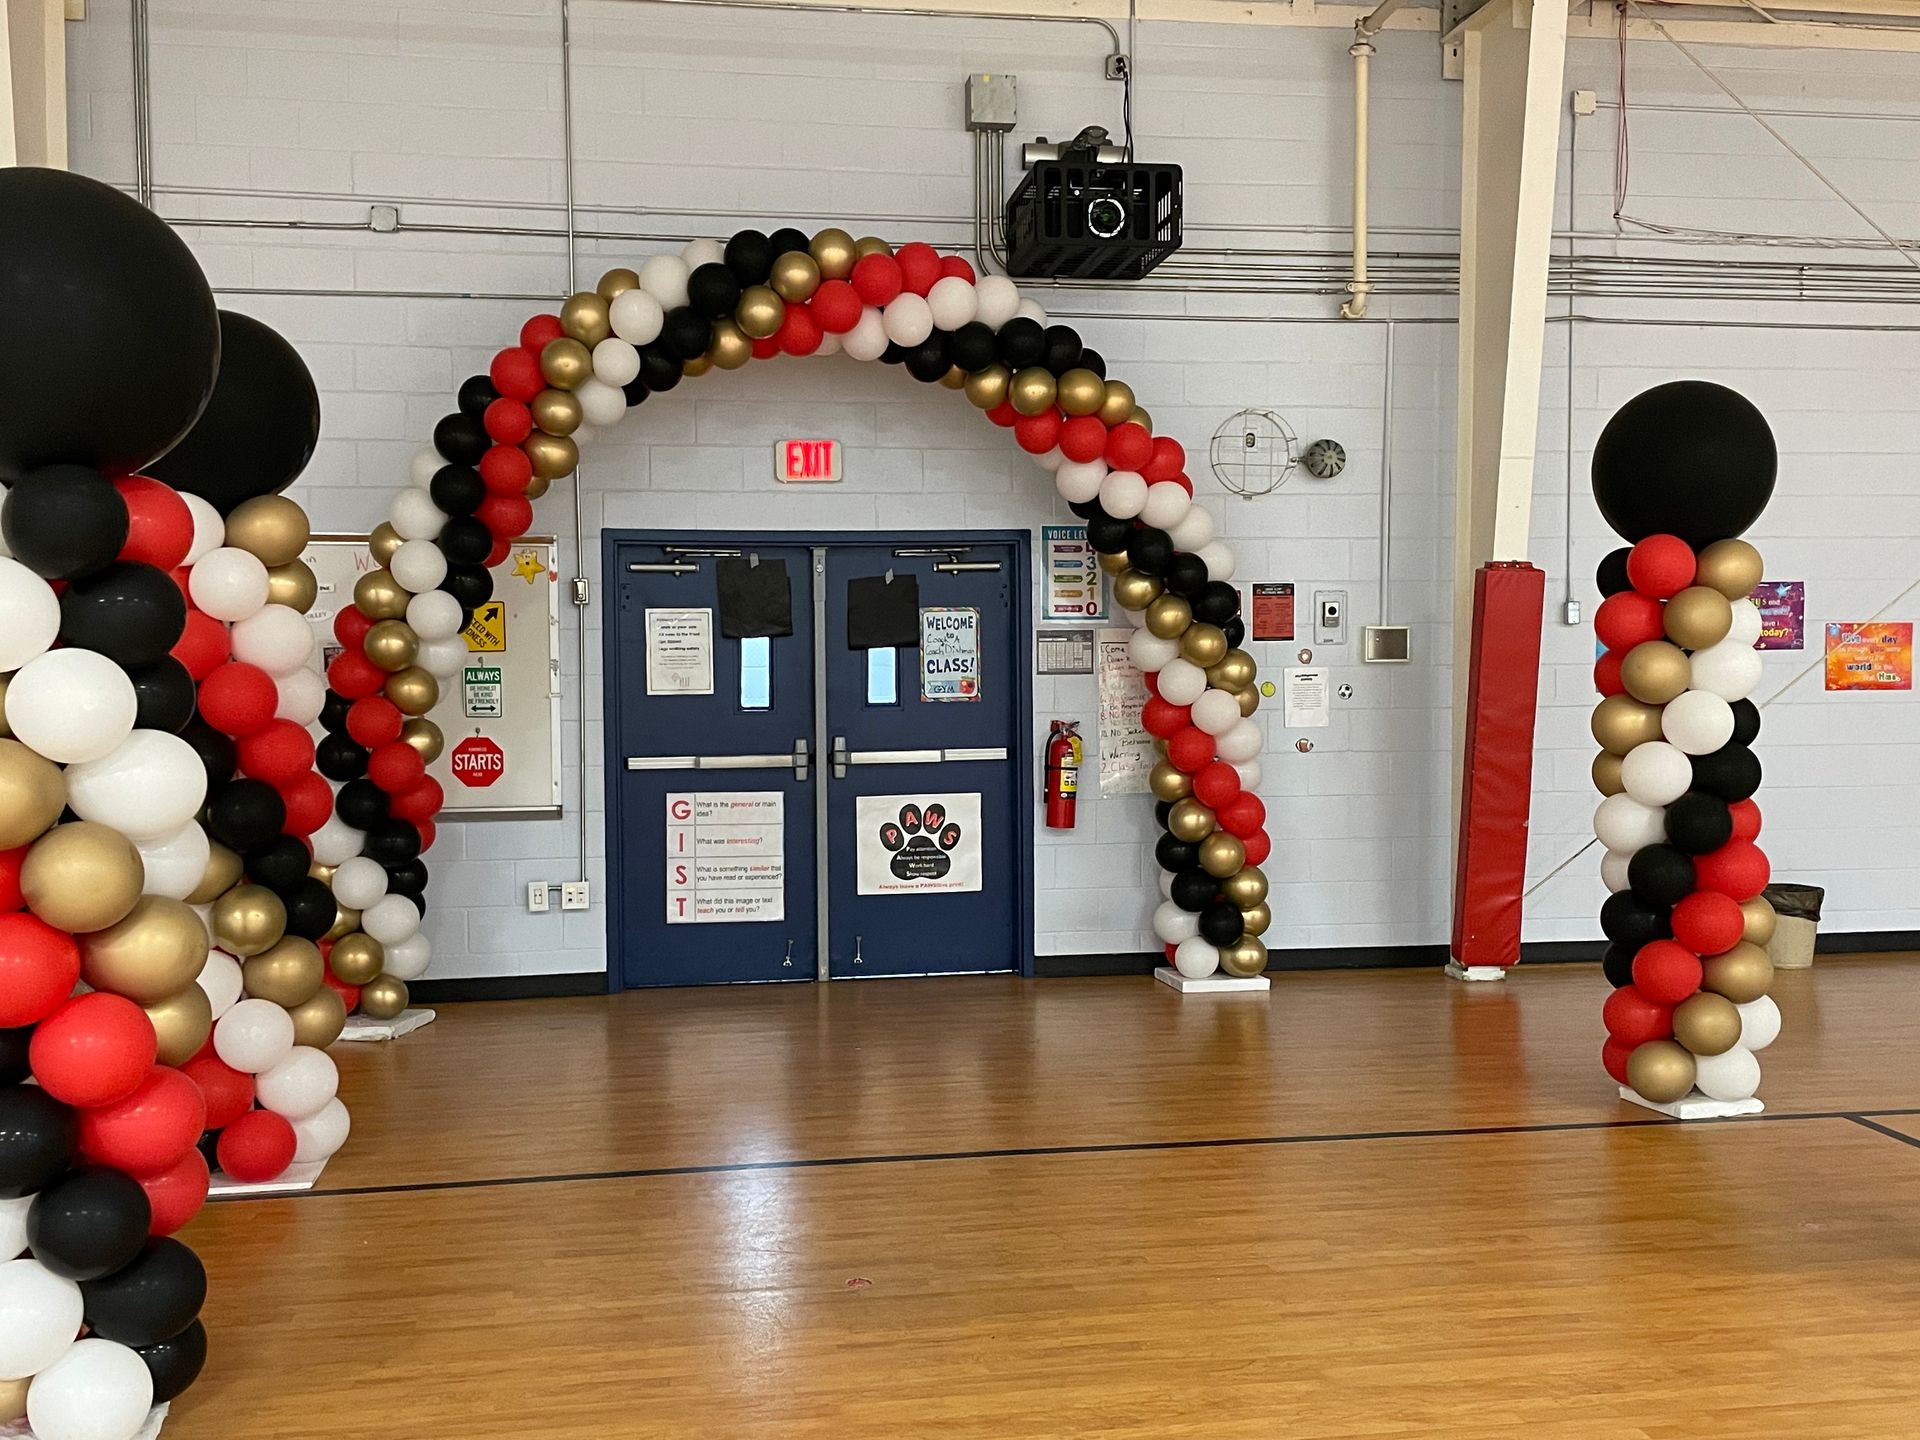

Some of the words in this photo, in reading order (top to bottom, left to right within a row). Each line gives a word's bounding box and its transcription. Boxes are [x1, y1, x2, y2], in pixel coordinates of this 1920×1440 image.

[785, 440, 834, 479] EXIT
[1048, 529, 1071, 540] VOICE
[1085, 556, 1097, 570] 3
[1085, 571, 1097, 586] 2
[1087, 586, 1095, 601] 1
[1085, 601, 1098, 616] 0
[926, 615, 974, 631] WELCOME
[484, 630, 501, 647] WITH
[1881, 635, 1898, 644] day
[1105, 644, 1125, 654] Come
[926, 657, 975, 674] CLASS!
[1846, 663, 1872, 671] world
[466, 671, 500, 681] ALWAYS
[933, 684, 955, 694] GYM
[454, 753, 502, 770] STARTS
[671, 799, 692, 821] G
[720, 800, 729, 808] the
[730, 800, 754, 809] general
[762, 800, 777, 808] main
[696, 837, 712, 845] What
[675, 864, 688, 885] S
[719, 865, 749, 873] something
[675, 897, 687, 917] T
[735, 897, 754, 906] image
[745, 905, 760, 914] you?
